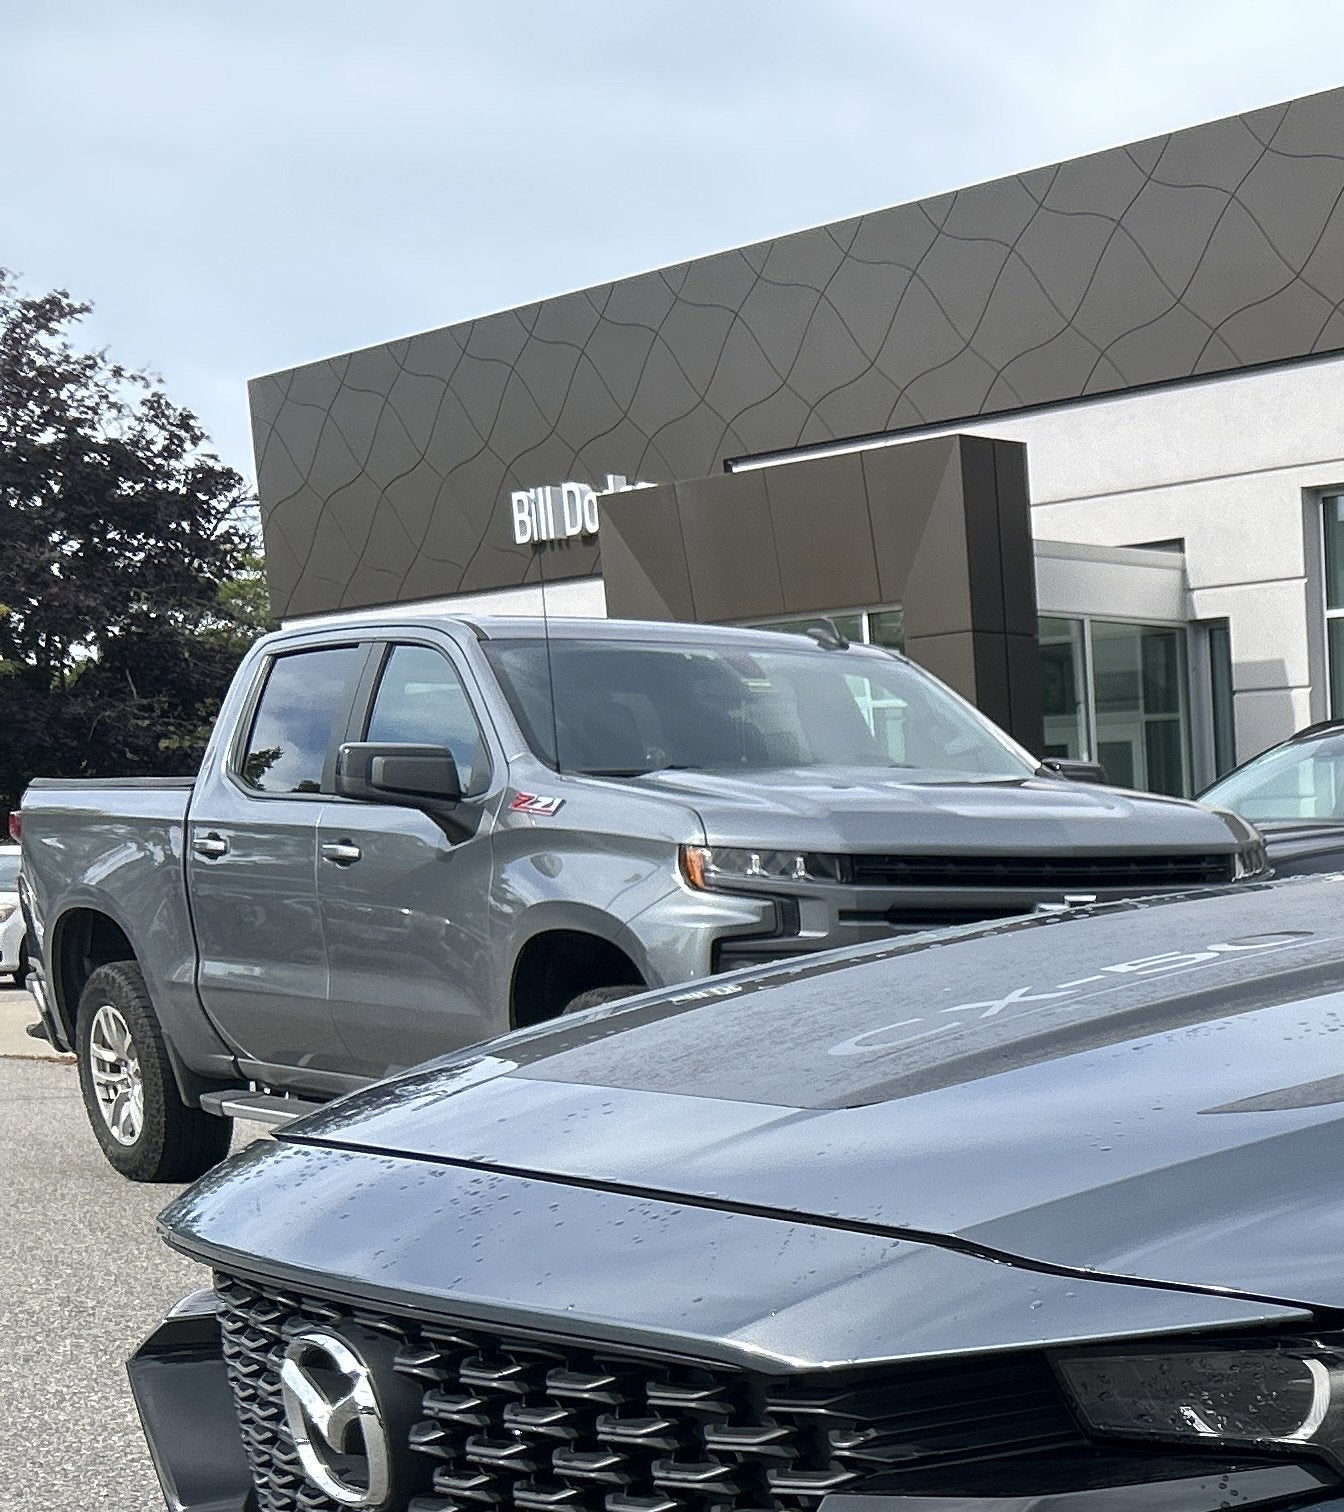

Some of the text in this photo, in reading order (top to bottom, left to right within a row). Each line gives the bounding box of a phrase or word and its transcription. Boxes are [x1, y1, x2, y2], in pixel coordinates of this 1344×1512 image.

[511, 474, 658, 544] Bill Do
[508, 791, 566, 816] Z71
[827, 931, 1314, 1056] CX-50
